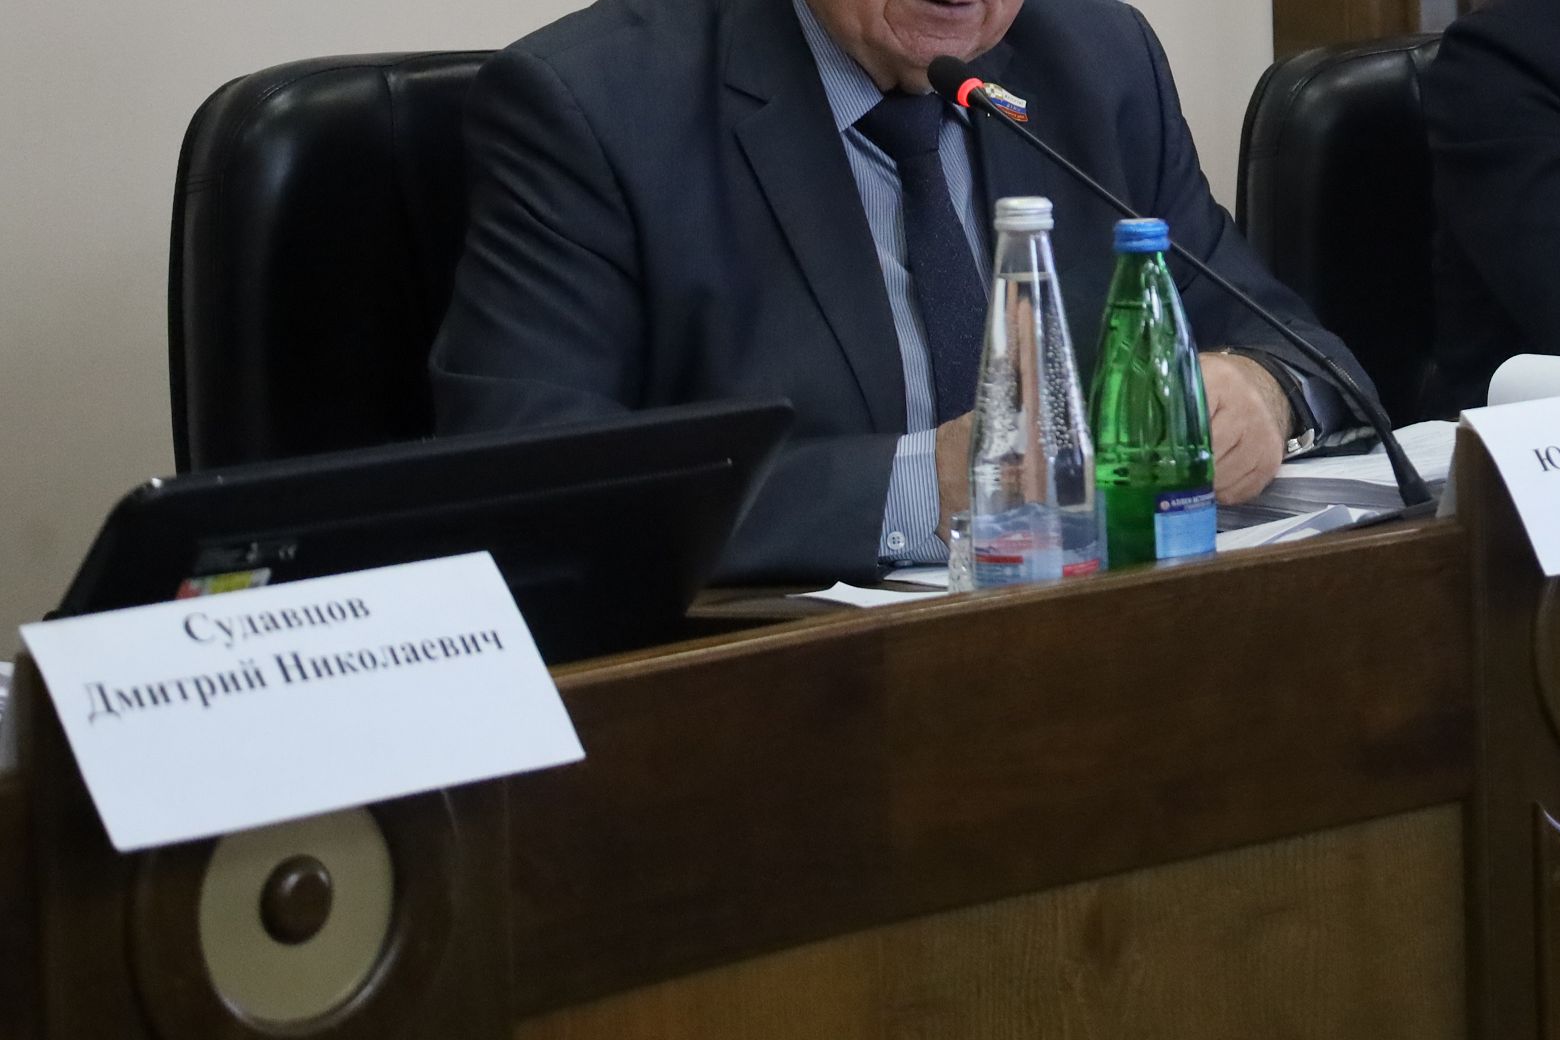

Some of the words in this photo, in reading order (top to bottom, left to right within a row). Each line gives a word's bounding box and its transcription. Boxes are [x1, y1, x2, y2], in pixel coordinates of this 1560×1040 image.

[182, 595, 371, 647] Судавцов
[86, 659, 267, 723] Дмитрий
[274, 628, 505, 686] Николаевич
